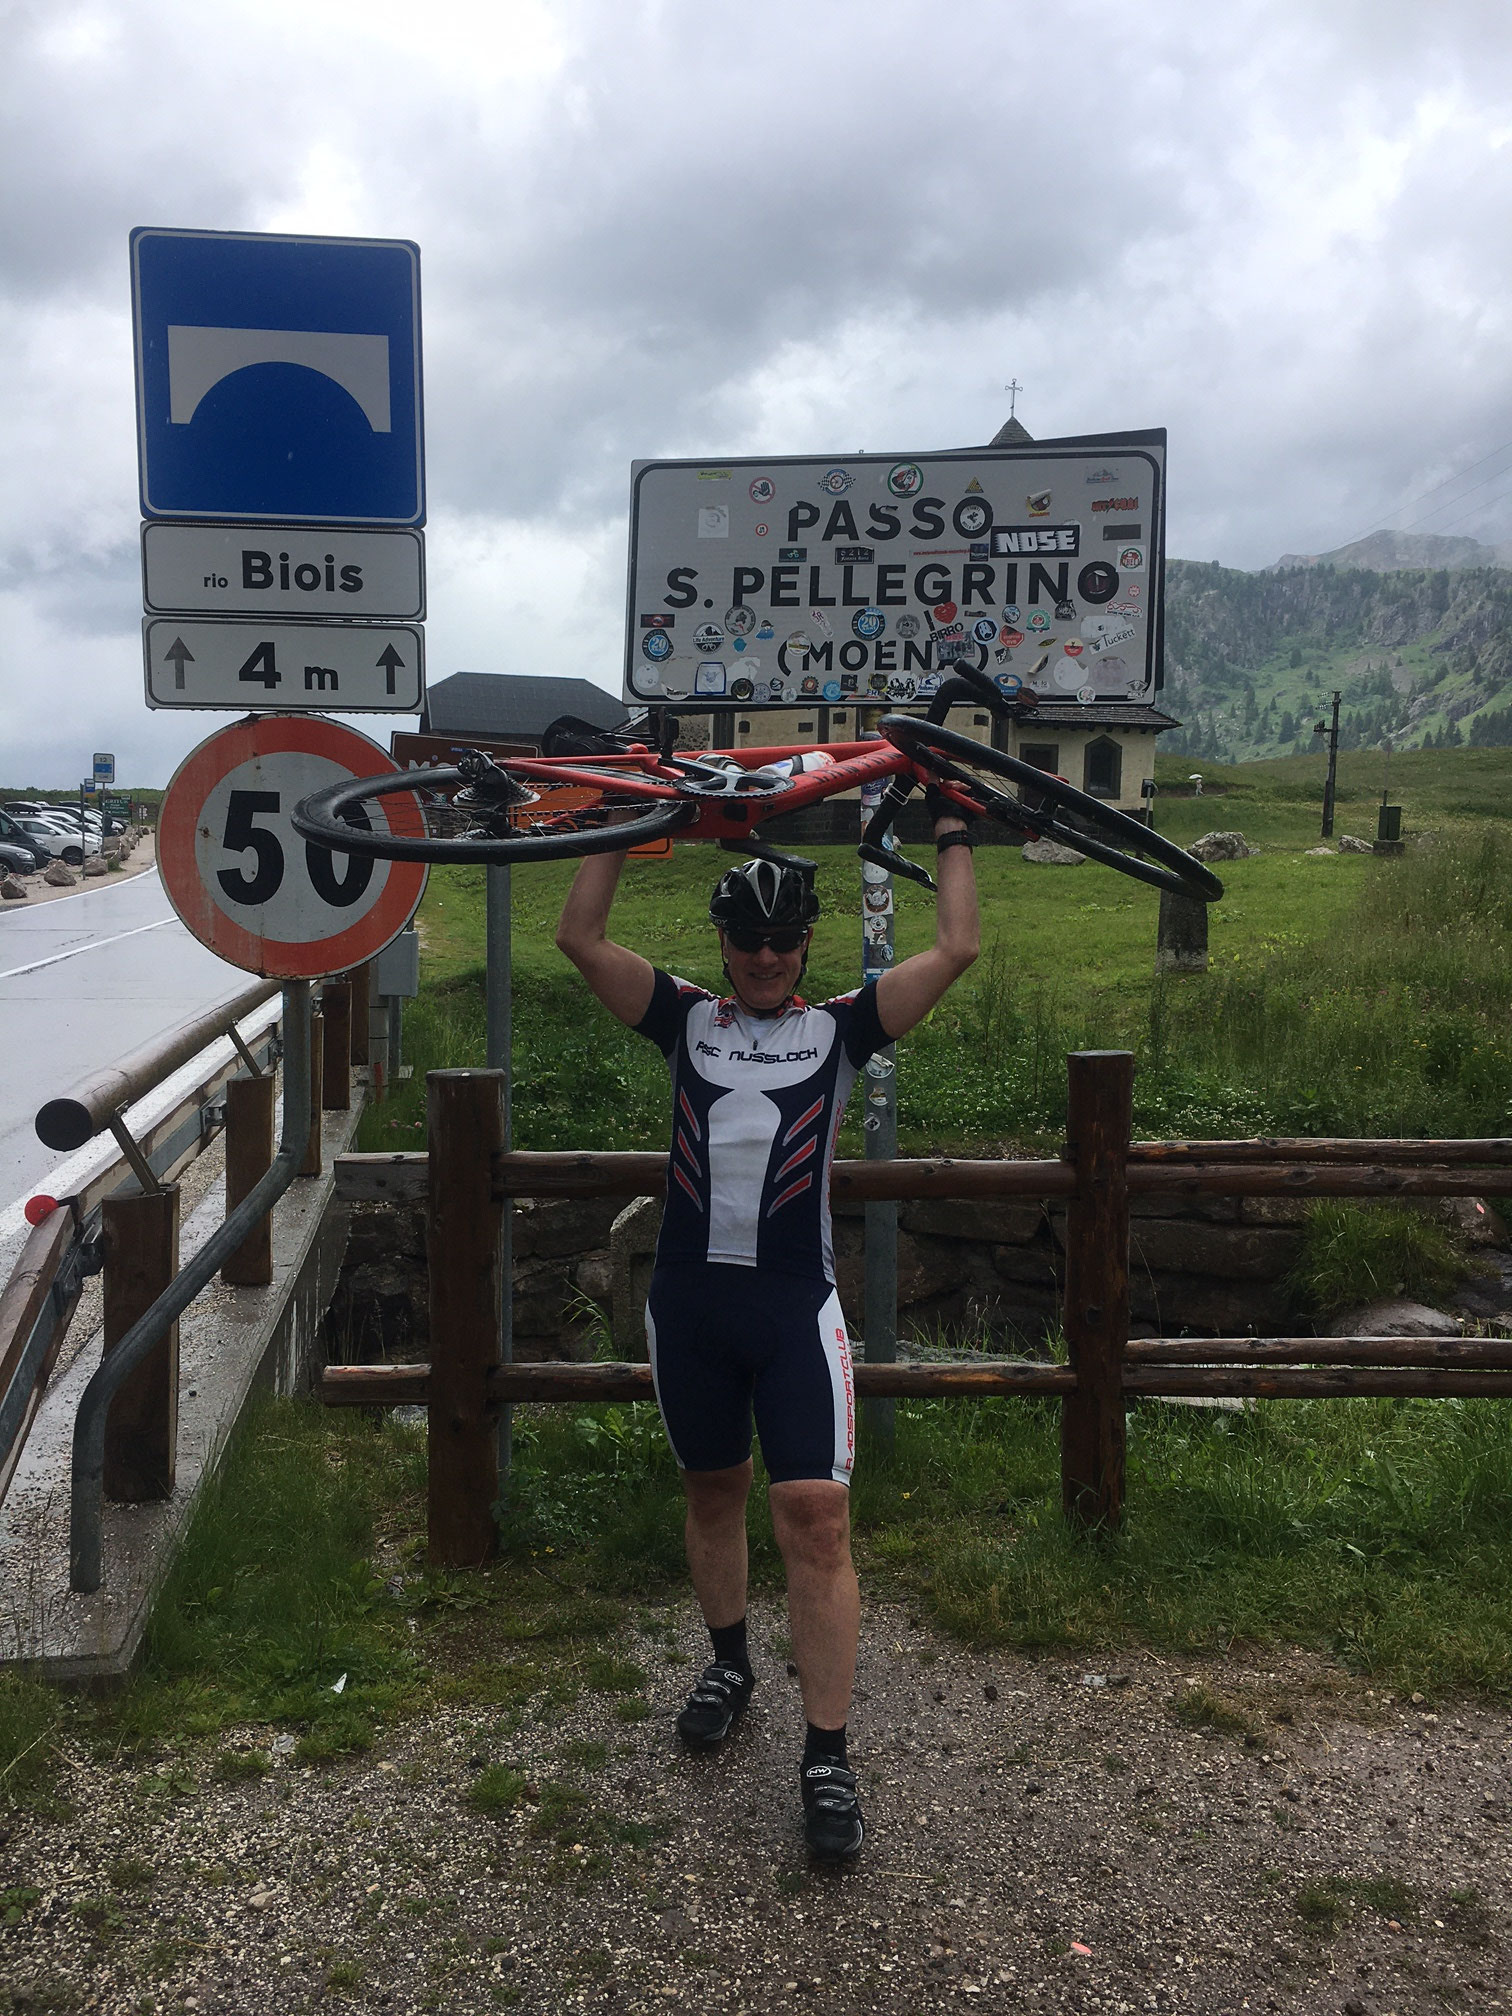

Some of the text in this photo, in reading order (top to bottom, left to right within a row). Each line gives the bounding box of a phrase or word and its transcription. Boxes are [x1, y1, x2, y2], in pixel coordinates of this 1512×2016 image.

[788, 496, 993, 541] PASSO
[995, 530, 1076, 552] NOSE
[203, 550, 364, 593] rio Biois
[663, 561, 1119, 608] S. PELLEGRINO
[929, 622, 964, 643] BIRRO
[1103, 628, 1136, 648] Tuckett
[239, 641, 338, 691] 4 m
[216, 790, 374, 907] 50
[727, 1672, 744, 1682] NW
[808, 1767, 829, 1776] NW
